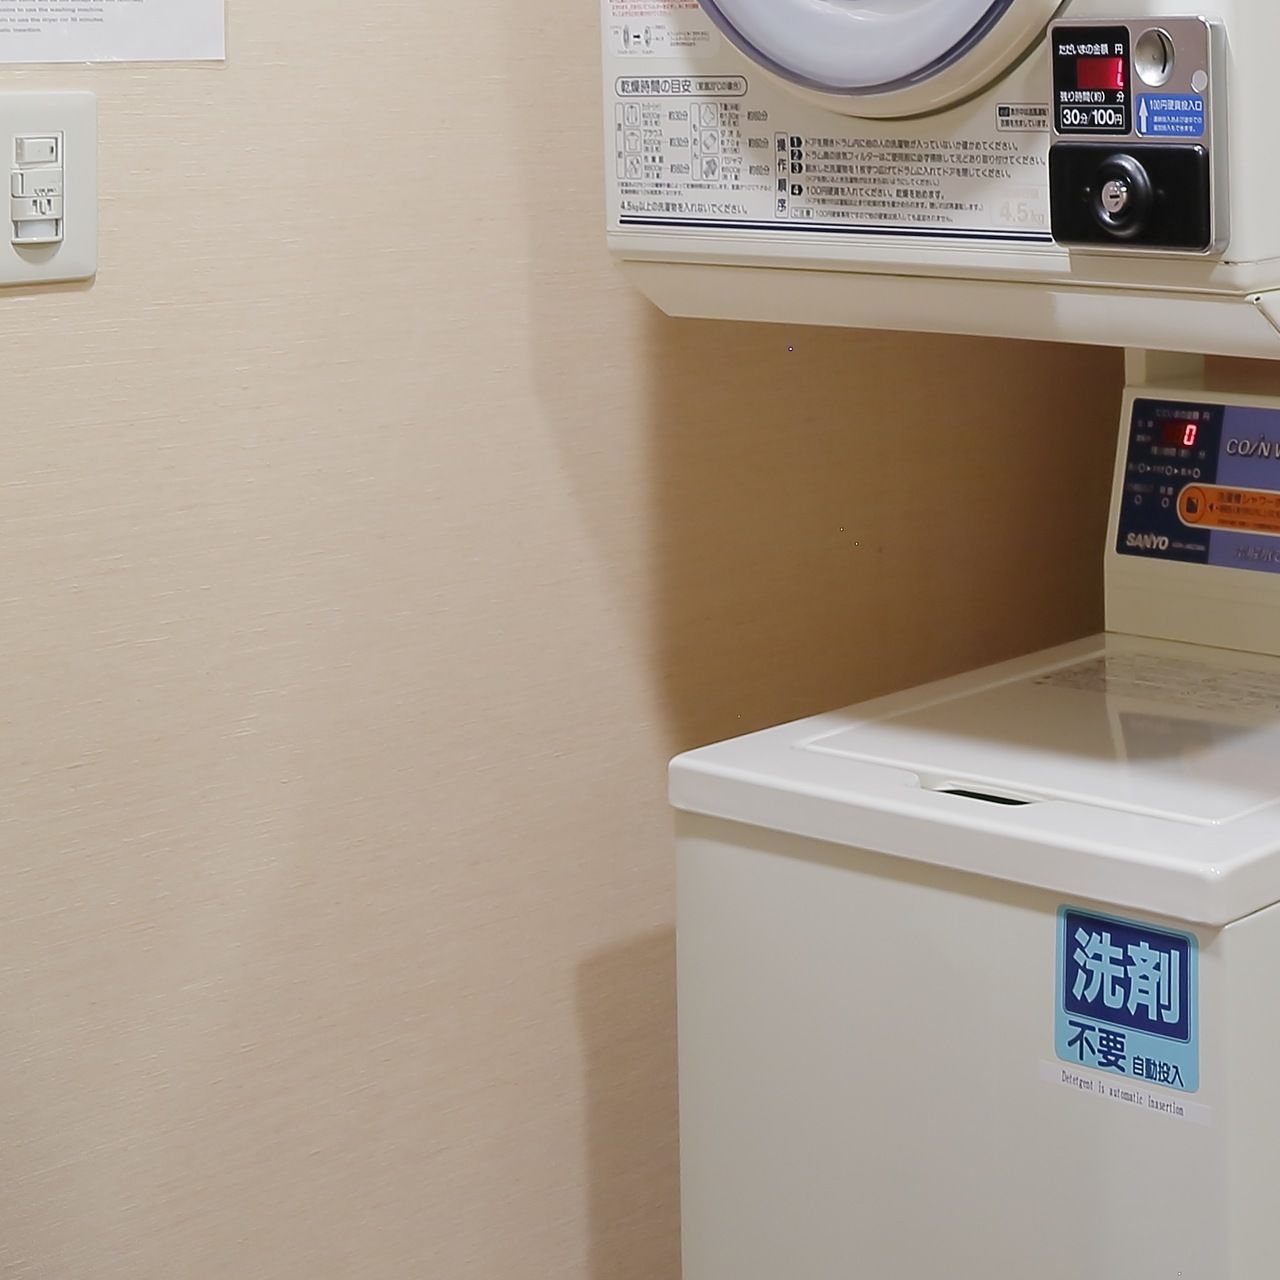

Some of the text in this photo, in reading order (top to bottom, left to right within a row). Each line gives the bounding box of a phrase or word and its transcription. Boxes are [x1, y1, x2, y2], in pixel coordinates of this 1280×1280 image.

[1183, 424, 1197, 445] 0
[1126, 533, 1169, 551] SANYO
[1072, 927, 1180, 1024] 洗剤
[1067, 1020, 1184, 1088] 不要 自動投入
[1109, 1087, 1143, 1105] automatic
